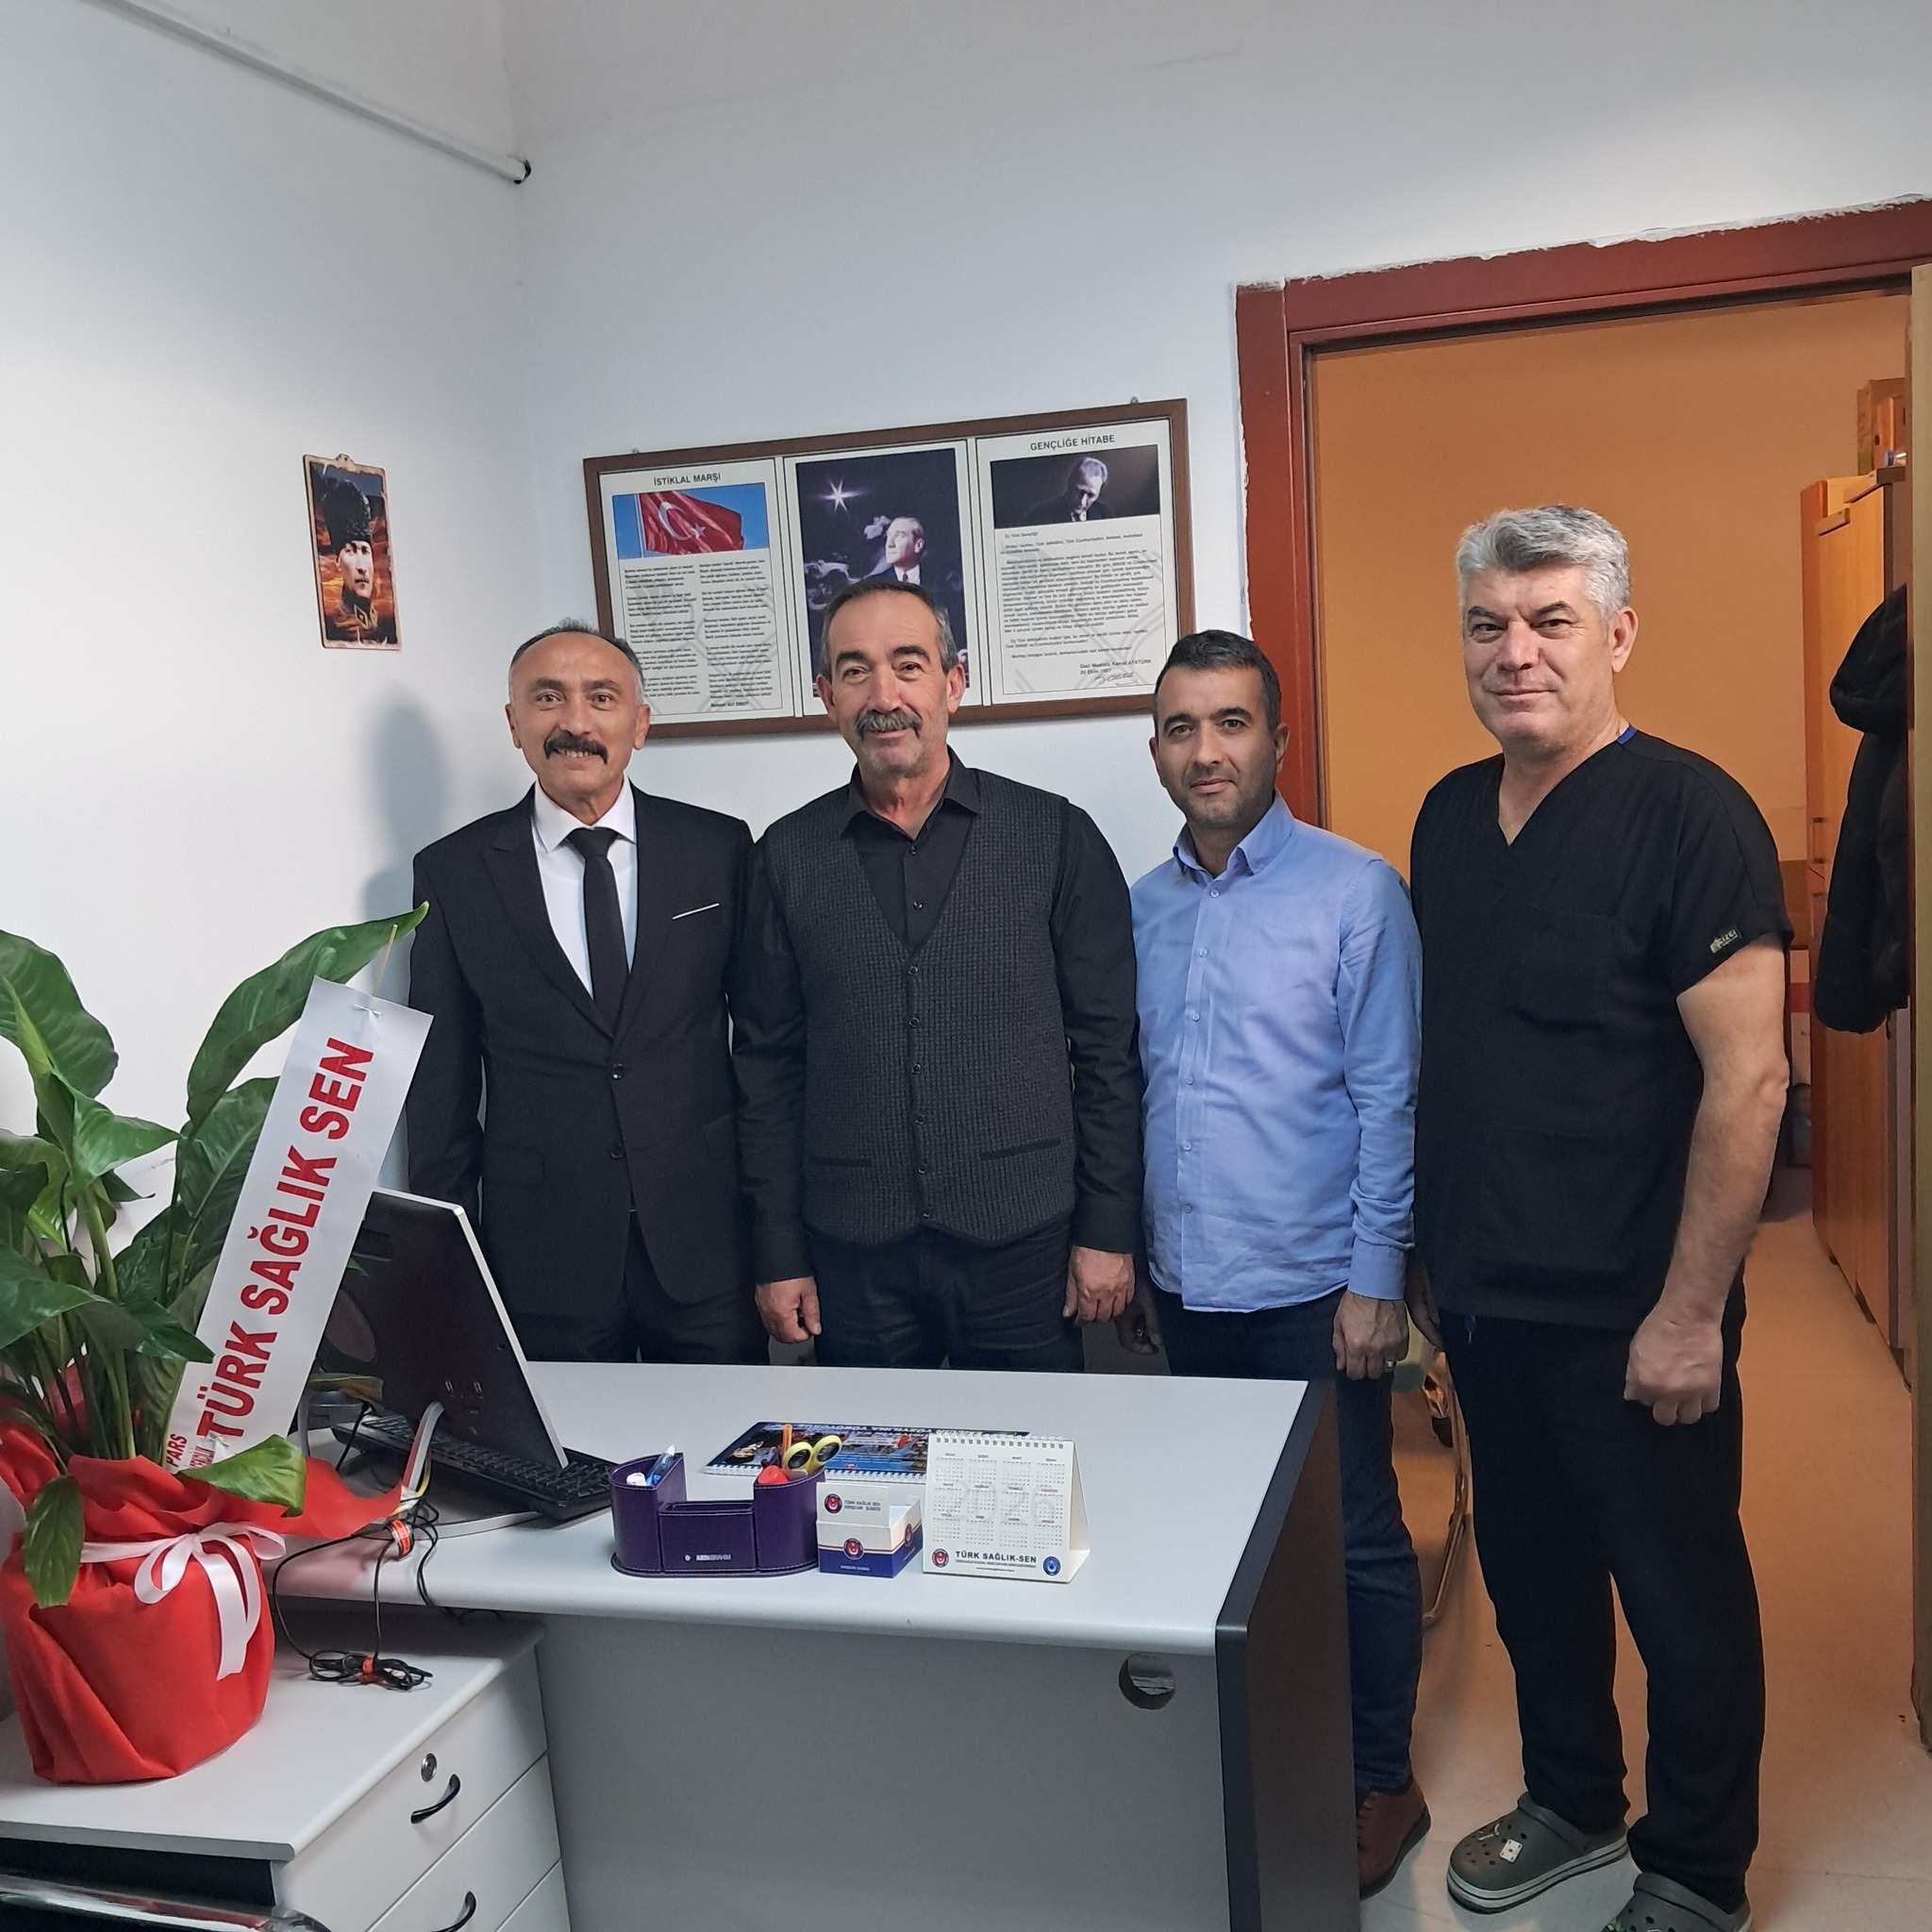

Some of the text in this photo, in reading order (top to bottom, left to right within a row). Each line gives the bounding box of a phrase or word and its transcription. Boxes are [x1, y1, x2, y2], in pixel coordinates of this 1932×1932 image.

[1030, 434, 1115, 451] GENÇLİĞE HİTABE
[654, 473, 721, 486] İSTİKLAL MARŞI
[197, 1038, 375, 1437] TÜRK SAĞLIK SEN
[166, 1434, 188, 1468] PARS
[956, 1550, 980, 1559] TÜRK
[982, 1552, 1037, 1563] SAĞLIK-SEN
